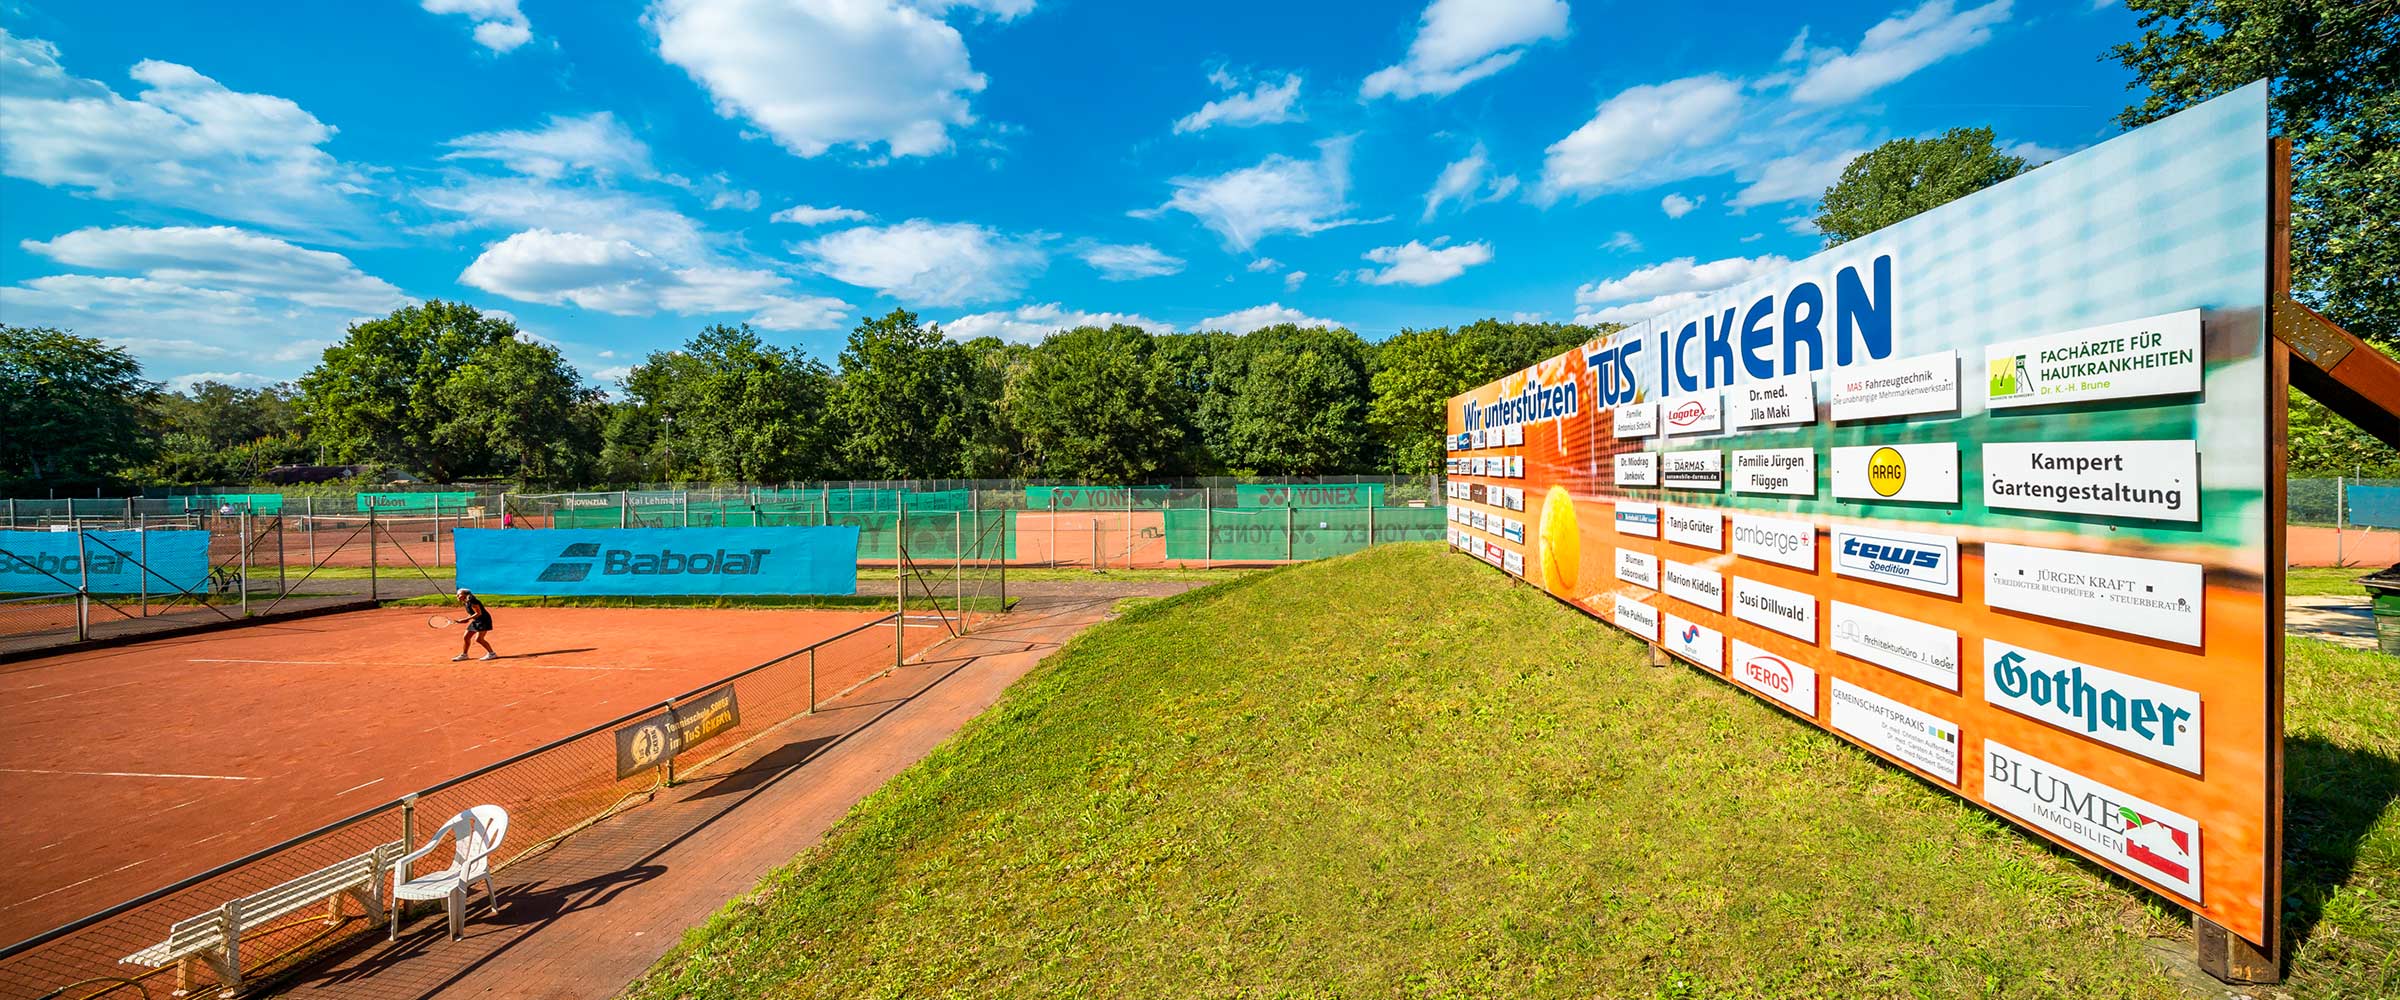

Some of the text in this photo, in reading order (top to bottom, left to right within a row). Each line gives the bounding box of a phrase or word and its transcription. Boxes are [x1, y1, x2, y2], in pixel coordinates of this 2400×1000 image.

[1464, 400, 1481, 431] Wir
[1485, 380, 1576, 429] unterstützen
[1660, 254, 1891, 397] ICKERN
[2040, 331, 2162, 363] FACHÄRZTE FÜR
[2040, 349, 2193, 382] HAUTKRANKHEITEN
[1847, 370, 1933, 392] MAS Fahrzeugtechnik
[2040, 386, 2055, 396] Dr.
[2081, 379, 2111, 392] Brune
[1749, 385, 1788, 401] Dr. med.
[1668, 408, 1706, 421] Logotex
[1750, 405, 1790, 421] Jila Maki
[1628, 457, 1649, 468] Miodrag
[1674, 460, 1705, 471] DARMAS
[1738, 454, 1804, 471] Familie Jürgen
[1872, 464, 1901, 480] ARAG
[2031, 453, 2123, 474] Kampert
[1751, 474, 1789, 490] Flüggen
[628, 496, 642, 505] Kai
[1297, 487, 1359, 506] YONEX
[1992, 479, 2181, 510] Gartengestaltung
[1669, 517, 1688, 532] Tanja
[1688, 520, 1714, 535] Grüter
[1735, 524, 1798, 555] amberge
[1625, 553, 1644, 567] Blumen
[1843, 537, 1941, 569] tews
[1868, 561, 1910, 576] Spedition
[1666, 571, 1720, 597] Marion Kiddler
[2036, 568, 2136, 593] JÜRGEN KRAFT
[1993, 576, 2192, 613] VEREIDIGTER BUCHPRÜFER STEUERBERATER
[1617, 604, 1630, 619] Silke
[1739, 591, 1804, 622] Susi Dillwald
[1863, 634, 1954, 671] Architekturbüro J. Leder
[1993, 651, 2192, 747] Gothaer
[1832, 688, 1925, 733] GEMEINSCHAFTSPRAXIS
[702, 710, 732, 735] ICKERN
[1989, 751, 2125, 836] BLUME
[2032, 802, 2124, 854] IMMOBILIEN
